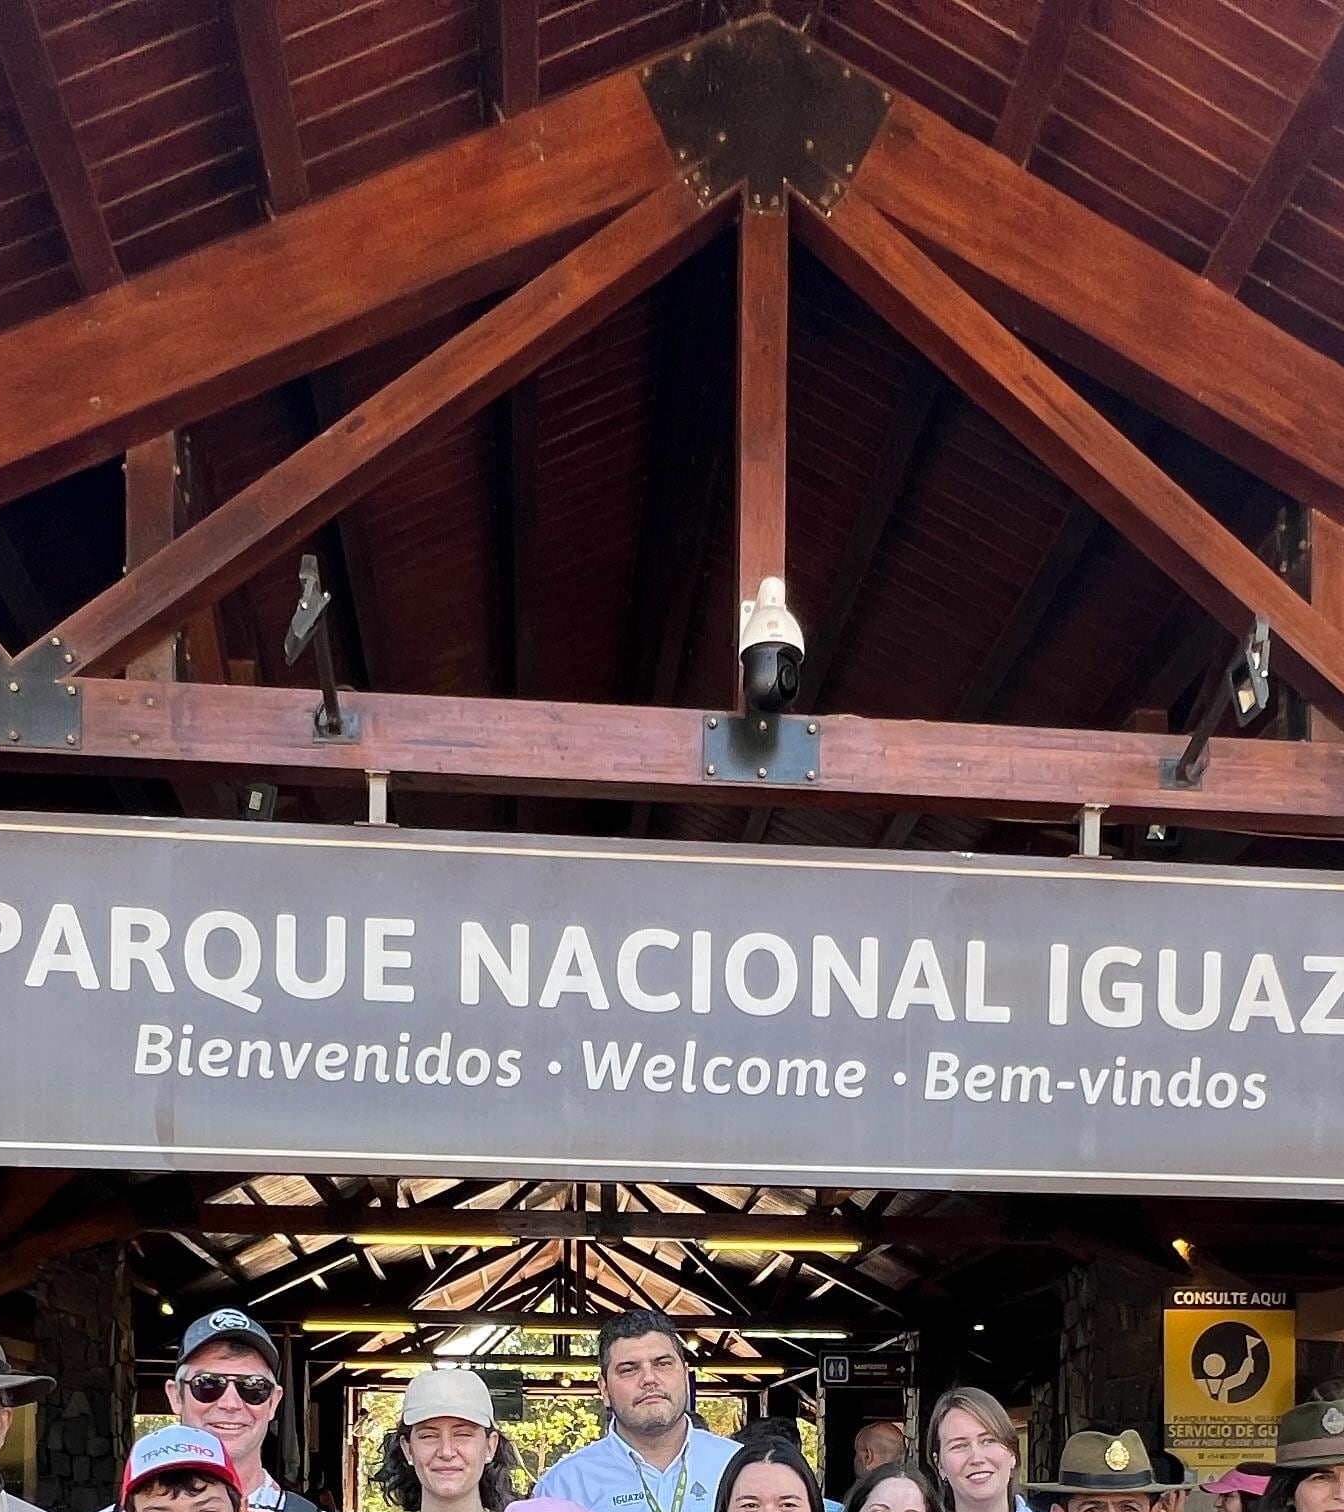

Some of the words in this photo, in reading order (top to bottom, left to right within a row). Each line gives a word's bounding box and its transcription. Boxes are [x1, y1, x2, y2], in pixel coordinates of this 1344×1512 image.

[460, 920, 1011, 1025] NACIONAL
[133, 1024, 523, 1086] Bienvenidos
[583, 1040, 866, 1099] Welcome
[923, 1051, 1268, 1111] Bem-vindos
[1173, 1291, 1248, 1305] CONSULTE
[1254, 1415, 1280, 1423] IGUAZ
[1167, 1424, 1233, 1438] SERVICIO
[1235, 1424, 1255, 1438] DE
[1257, 1424, 1279, 1438] GU
[612, 1492, 644, 1505] IGUAZÚ
